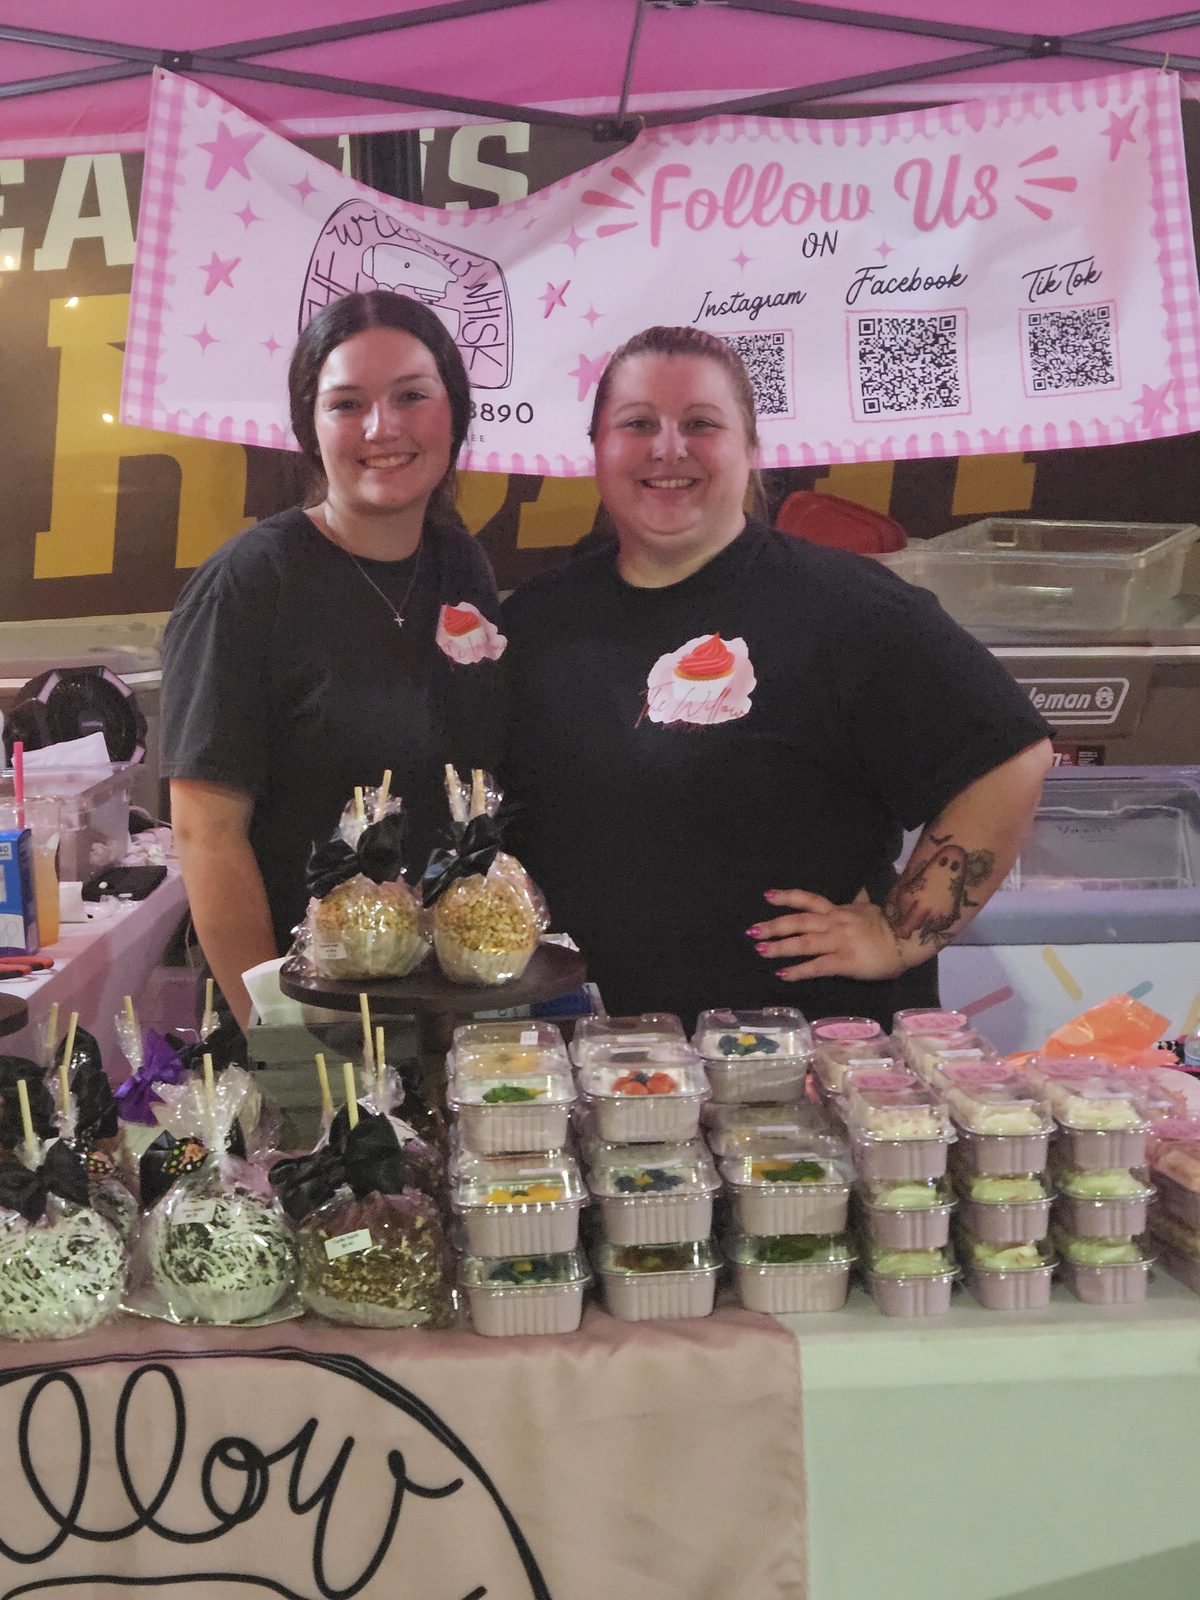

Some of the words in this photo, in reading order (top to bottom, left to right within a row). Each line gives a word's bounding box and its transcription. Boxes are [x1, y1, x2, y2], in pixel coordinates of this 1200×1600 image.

[650, 161, 876, 248] Follow
[894, 153, 999, 232] Us
[802, 230, 838, 258] ON
[307, 251, 359, 321] HE
[846, 264, 969, 305] Facebook
[693, 290, 807, 323] Instagram
